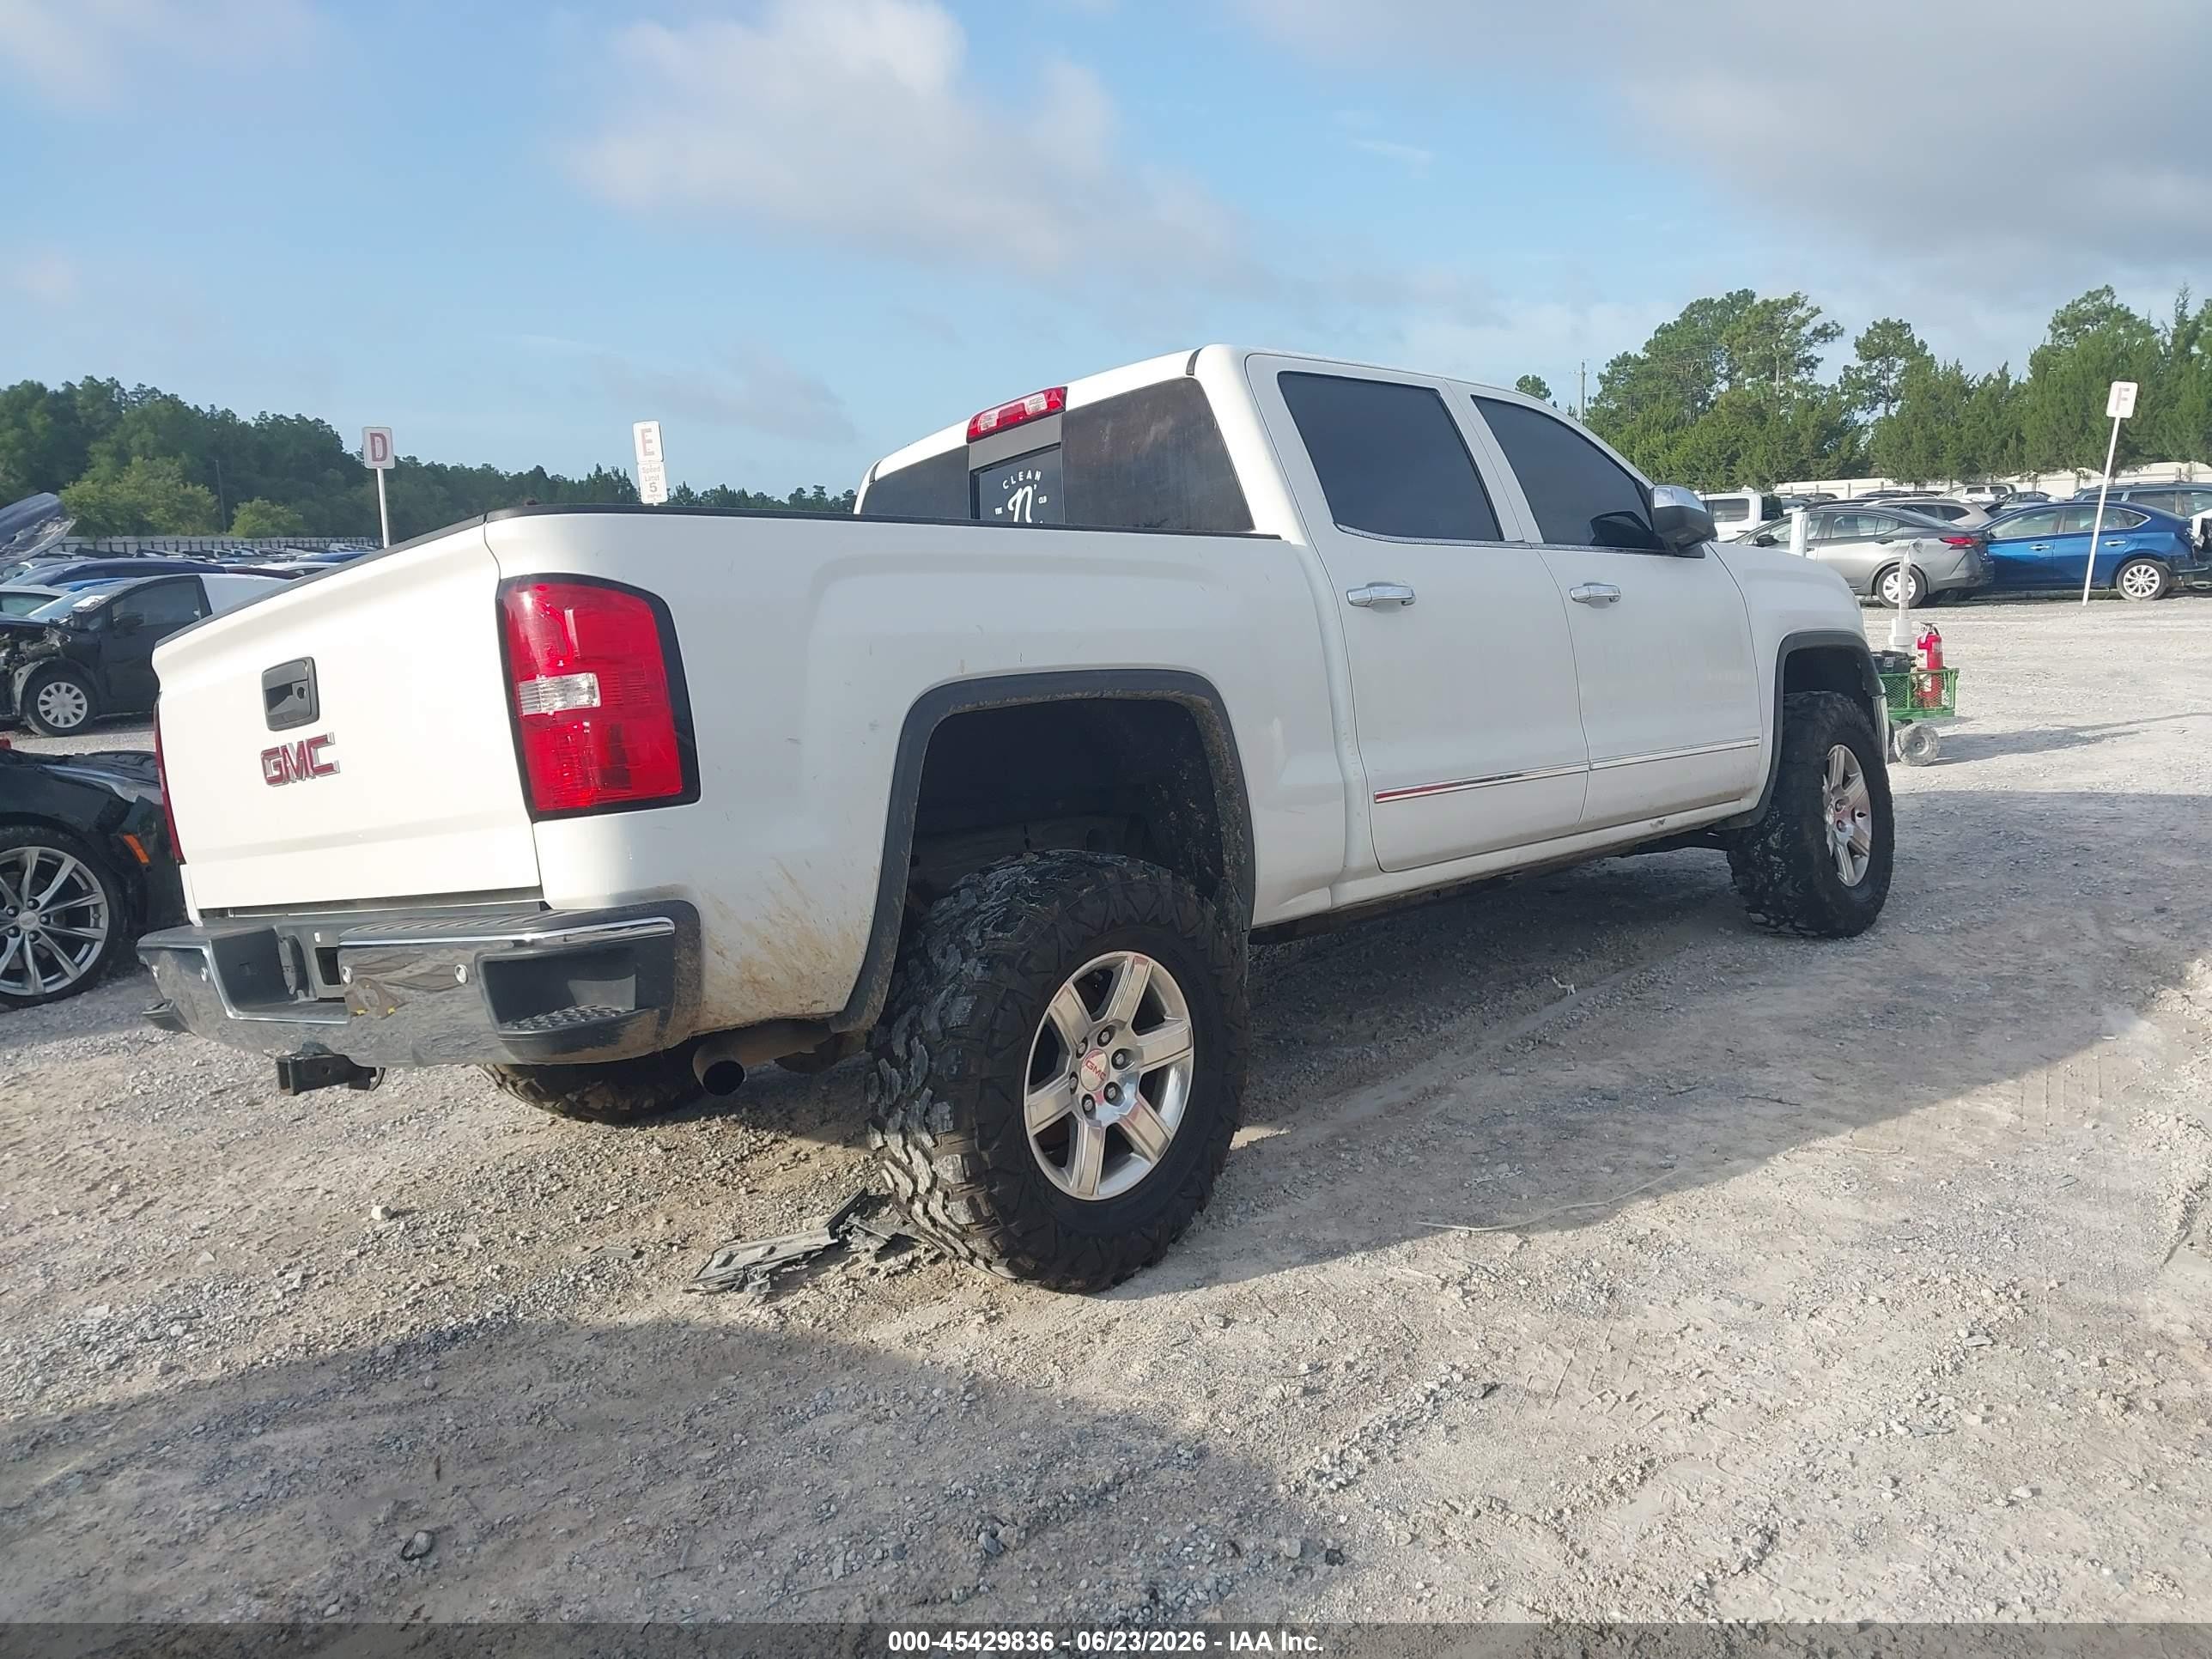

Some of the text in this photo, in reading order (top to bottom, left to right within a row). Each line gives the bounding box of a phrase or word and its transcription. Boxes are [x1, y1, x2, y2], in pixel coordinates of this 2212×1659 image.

[2115, 387, 2130, 411] F
[369, 432, 387, 462] D
[641, 428, 655, 456] E
[649, 482, 658, 493] 5
[1002, 469, 1042, 489] CLEAN
[260, 732, 341, 787] GMC
[1085, 1059, 1107, 1081] GMC
